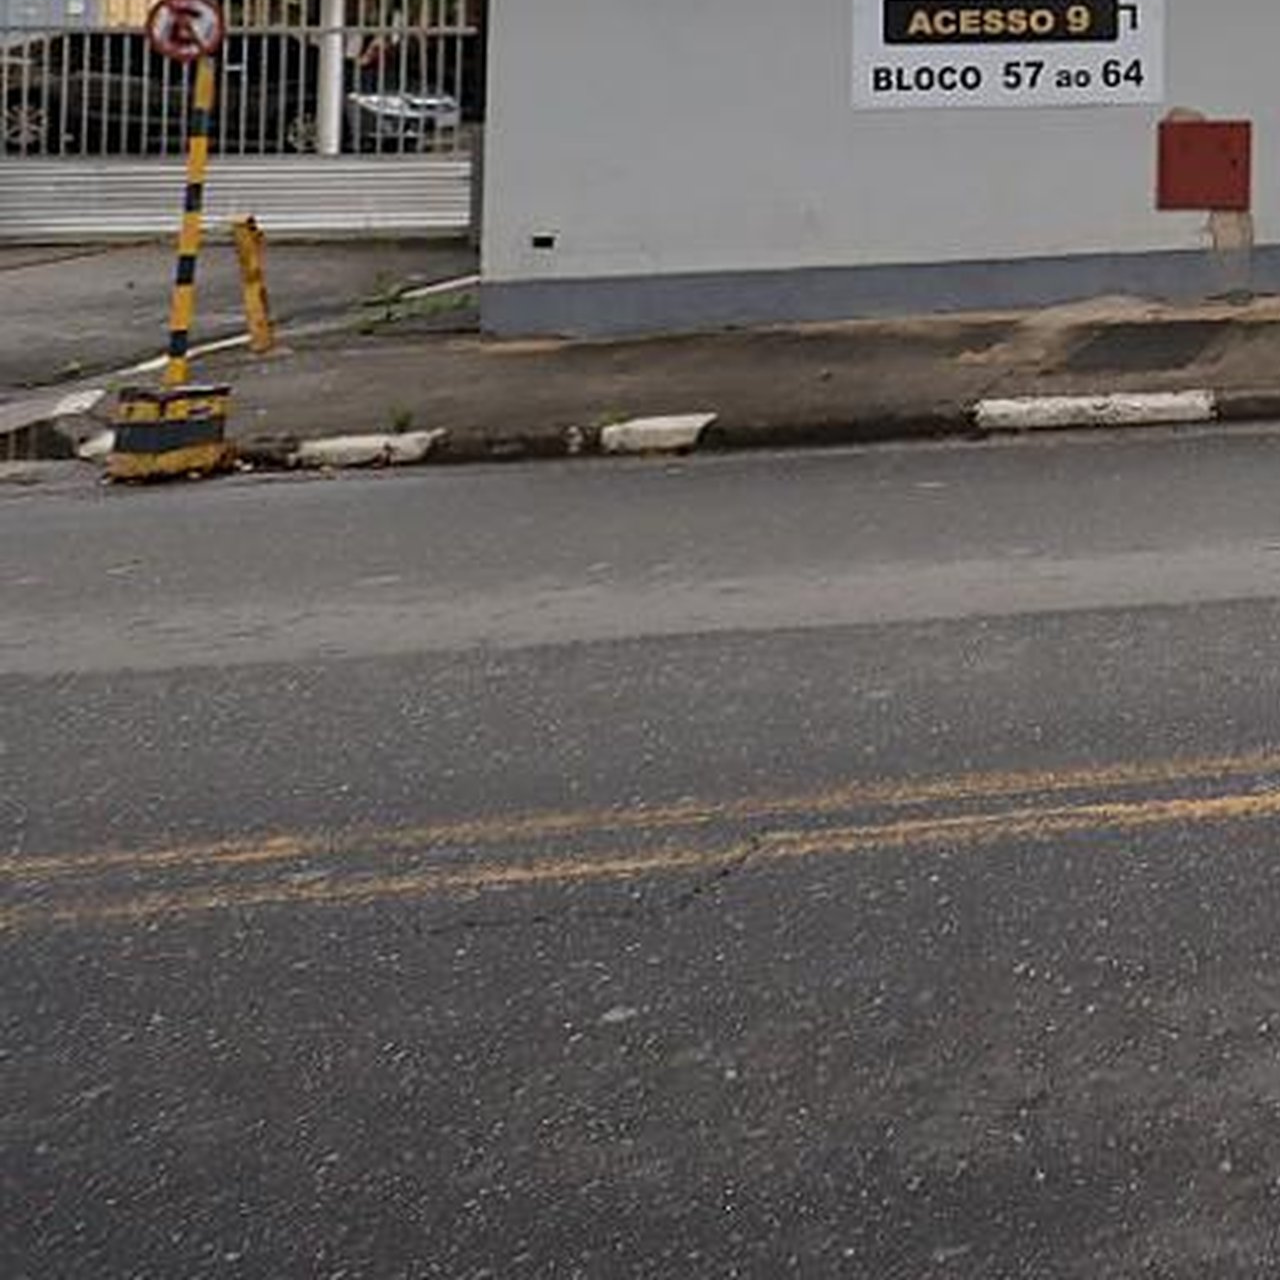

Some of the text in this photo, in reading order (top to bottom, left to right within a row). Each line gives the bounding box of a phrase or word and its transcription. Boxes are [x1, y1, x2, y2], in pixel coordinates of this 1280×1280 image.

[908, 5, 1091, 35] ACESSO 9
[873, 59, 1143, 91] BLOCO 57 ao 64
